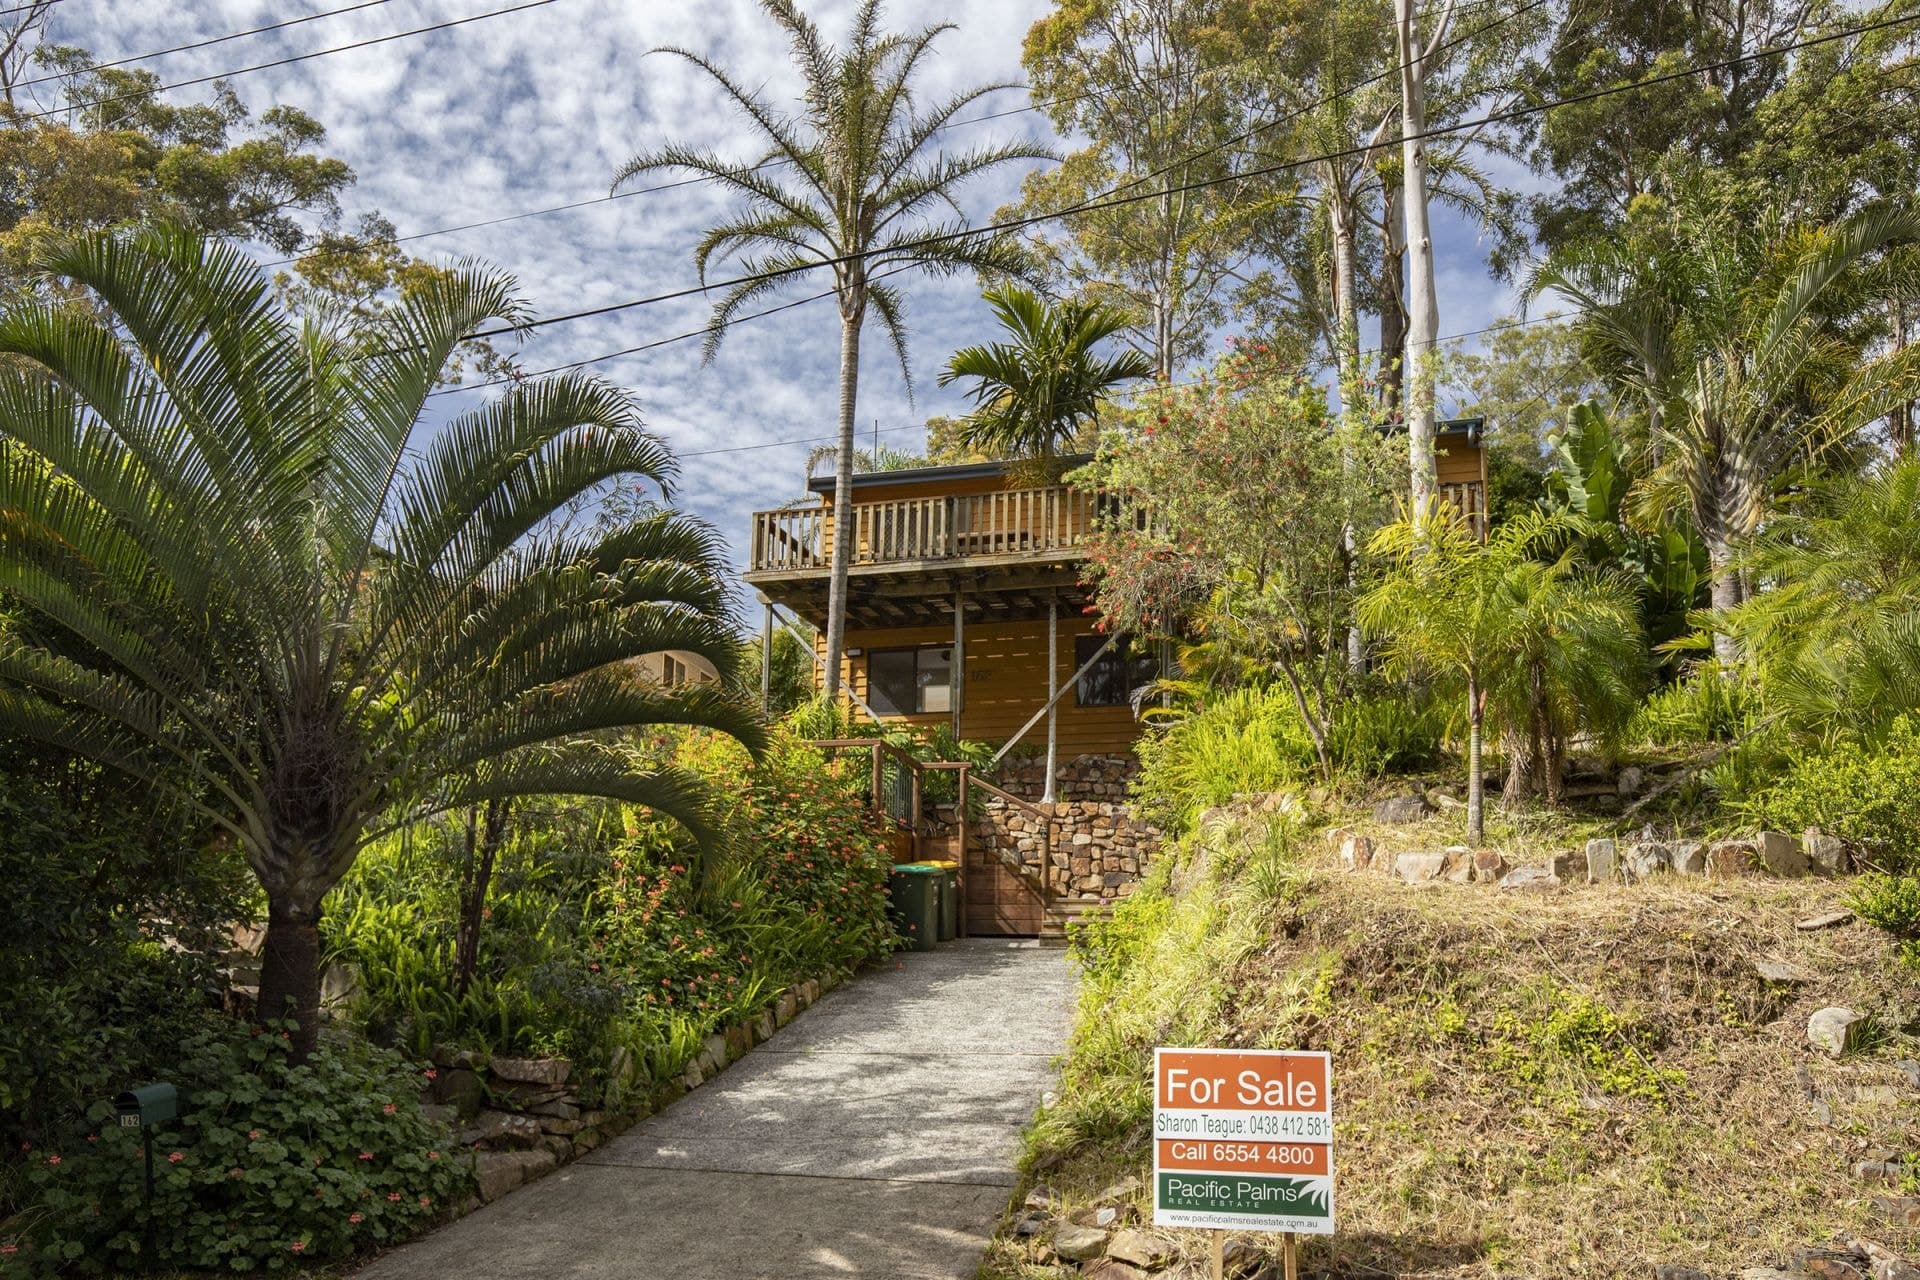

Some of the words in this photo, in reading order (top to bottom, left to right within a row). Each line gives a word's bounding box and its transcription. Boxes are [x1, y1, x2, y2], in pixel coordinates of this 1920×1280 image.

[1167, 1069, 1226, 1104] For
[1237, 1070, 1317, 1107] Sale
[1158, 1113, 1198, 1132] Sharon
[1201, 1114, 1246, 1138] Teague:
[1250, 1115, 1278, 1135] 0438
[1282, 1117, 1303, 1135] 412
[1307, 1117, 1328, 1136] 581
[1171, 1142, 1207, 1161] Call
[1213, 1144, 1260, 1162] 6554
[1266, 1145, 1314, 1165] 4800
[1168, 1178, 1231, 1198] Pacific
[1237, 1182, 1297, 1201] Palms
[1168, 1198, 1200, 1206] REAL
[1211, 1200, 1260, 1208] ESTATE
[1170, 1214, 1318, 1228] www.pacificpalmsrealestate.com.au
